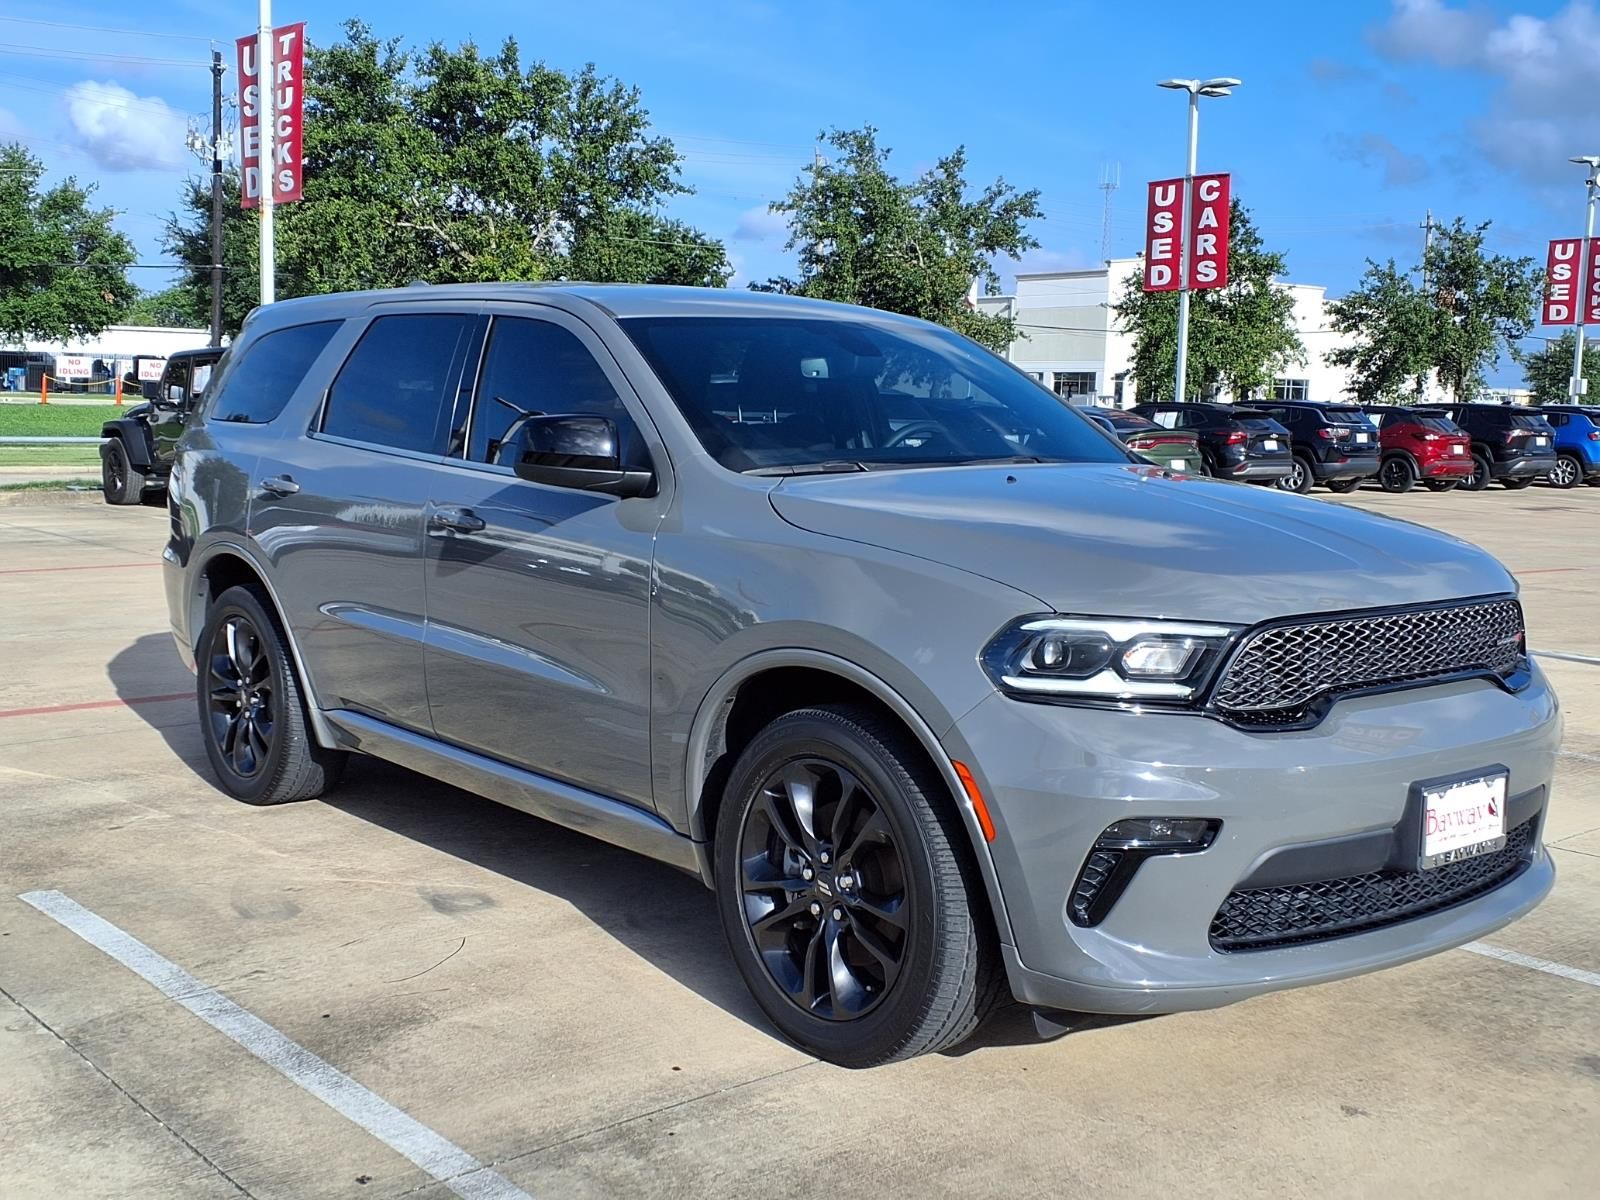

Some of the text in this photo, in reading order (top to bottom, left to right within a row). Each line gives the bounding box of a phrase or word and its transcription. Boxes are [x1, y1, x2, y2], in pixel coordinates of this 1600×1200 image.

[242, 44, 260, 199] USED
[277, 32, 296, 192] TRUCKS
[1150, 184, 1176, 286] USED
[1196, 179, 1221, 282] CARS
[1548, 243, 1575, 321] USED
[1444, 840, 1486, 863] BAYWAY
